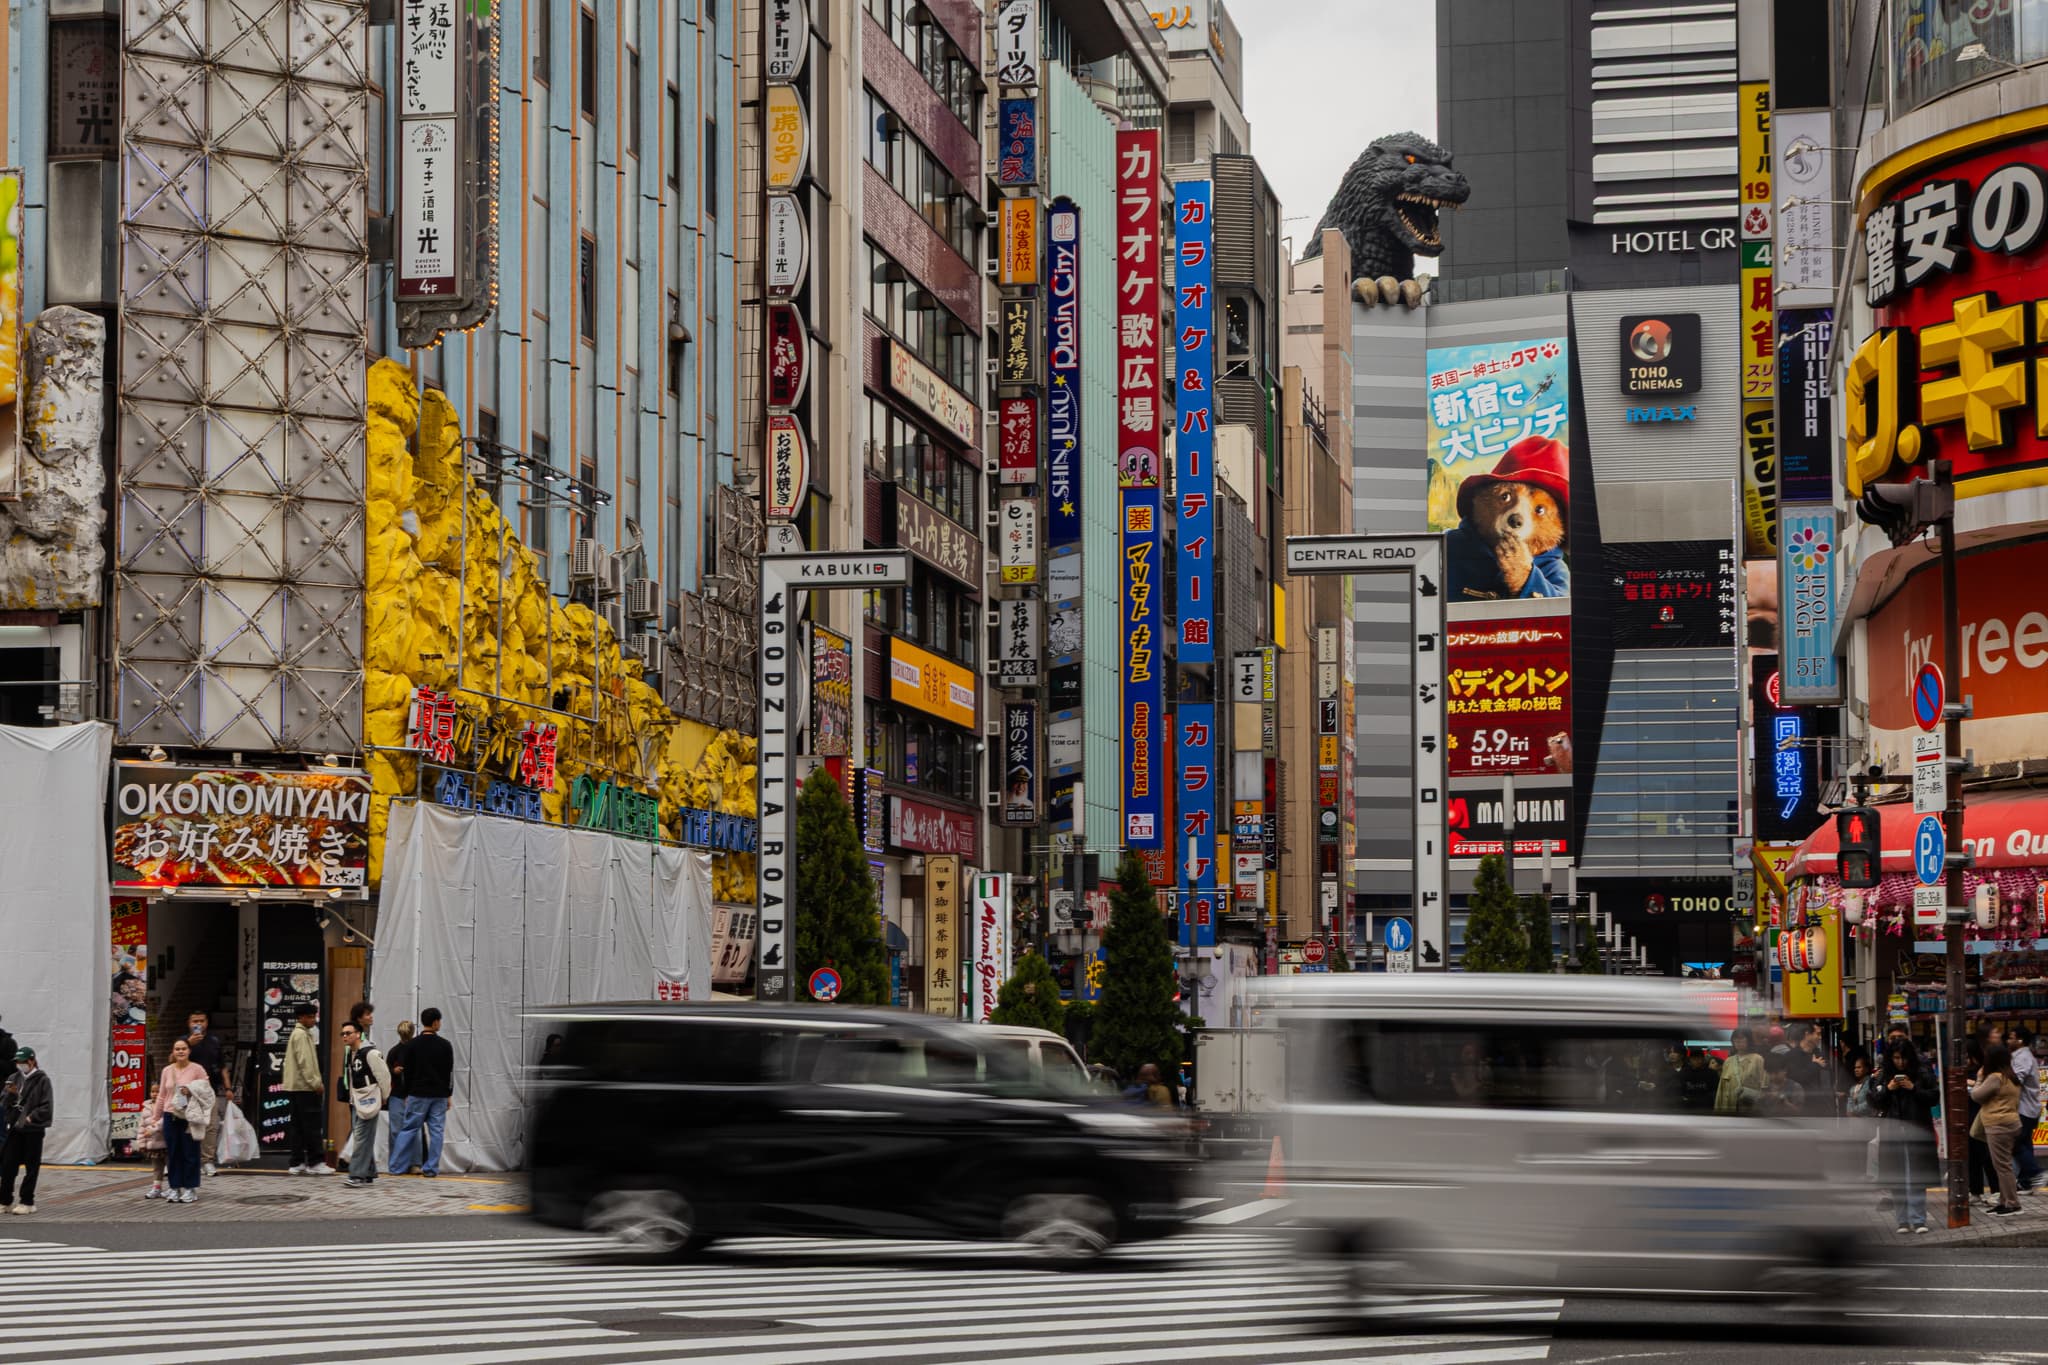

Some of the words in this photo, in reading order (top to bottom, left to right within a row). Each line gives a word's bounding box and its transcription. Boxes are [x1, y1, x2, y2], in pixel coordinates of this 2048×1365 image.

[1007, 14, 1028, 70] ダーツ
[770, 60, 793, 75] 6F
[1001, 113, 1035, 182] 海の家
[422, 157, 435, 222] チキン酒場
[771, 173, 789, 183] 4F
[417, 227, 440, 254] 光
[1612, 230, 1696, 254] HOTEL
[1865, 166, 2045, 306] 驚安の
[775, 258, 789, 273] 光
[419, 278, 438, 294] 4F
[1121, 143, 1155, 432] カラオケ歌広場
[1007, 303, 1029, 371] 山内農場
[1012, 370, 1024, 379] 5F
[1431, 347, 1539, 389] 英国一紳士なクマ
[1629, 366, 1668, 379] TOHO
[1629, 378, 1683, 390] CINEMAS
[1803, 323, 1818, 437] SHISHA
[1433, 382, 1524, 428] 新宿で
[1625, 405, 1697, 423] IMAX
[1052, 390, 1073, 498] SHINJUKU
[1439, 404, 1567, 465] 大ピンチ
[776, 432, 792, 506] お好み焼き
[1010, 469, 1026, 482] 4F
[1130, 508, 1152, 531] 薬
[909, 503, 968, 578] 山内農場
[1294, 549, 1367, 561] CENTRAL
[1373, 547, 1416, 559] ROAD
[1010, 567, 1029, 580] 3F
[1127, 541, 1152, 683] マツモトキヨシ
[1796, 576, 1811, 637] STAGE
[1811, 575, 1827, 627] IDOL
[1961, 611, 2048, 678] ree
[1448, 667, 1569, 698] パディントン
[1796, 658, 1825, 676] 5F
[764, 621, 785, 817] GODZILLA
[1010, 710, 1029, 761] 海の家
[1132, 702, 1149, 739] Shop
[1133, 739, 1149, 773] Free
[1471, 728, 1509, 753] 5.9
[1510, 736, 1530, 751] Fri
[1418, 633, 1438, 907] ゴジラロード
[1471, 755, 1529, 767] ロードショー
[118, 783, 371, 823] OKONOMIYAKI
[1133, 772, 1149, 798] Tax
[1476, 799, 1566, 824] MAUHAN
[131, 820, 351, 866] お好み焼き
[763, 841, 784, 934] ROAD
[1671, 897, 1721, 912] TOHO
